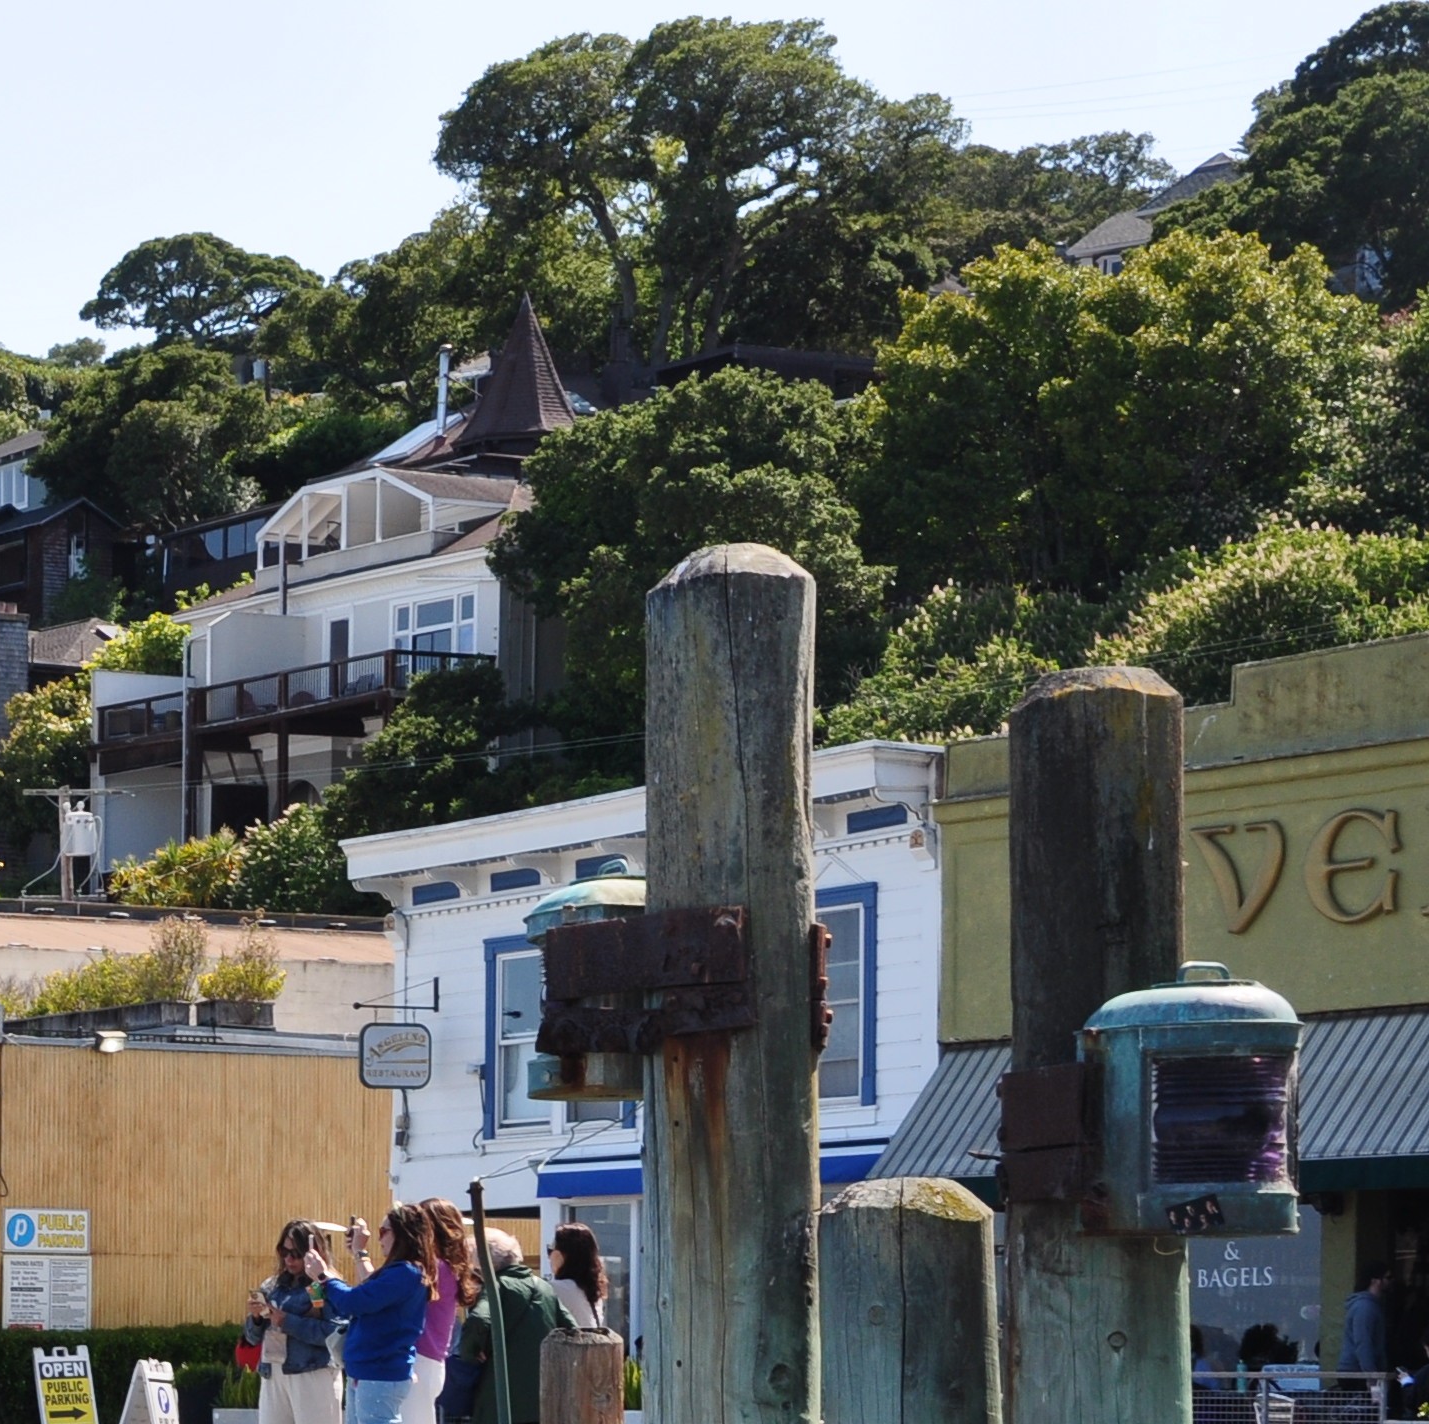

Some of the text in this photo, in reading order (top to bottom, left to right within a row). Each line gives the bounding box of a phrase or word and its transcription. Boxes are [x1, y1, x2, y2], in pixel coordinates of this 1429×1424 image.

[1190, 808, 1429, 936] VE
[365, 1032, 427, 1066] ANGELINO
[365, 1069, 427, 1078] RESTAURANT
[37, 1214, 86, 1231] PUBLIC
[37, 1233, 86, 1248] PARKING
[1224, 1240, 1241, 1261] &
[1197, 1266, 1274, 1288] BAGELS
[41, 1362, 86, 1378] OPEN
[47, 1381, 84, 1393] PUBLIC
[44, 1393, 90, 1406] PARKING
